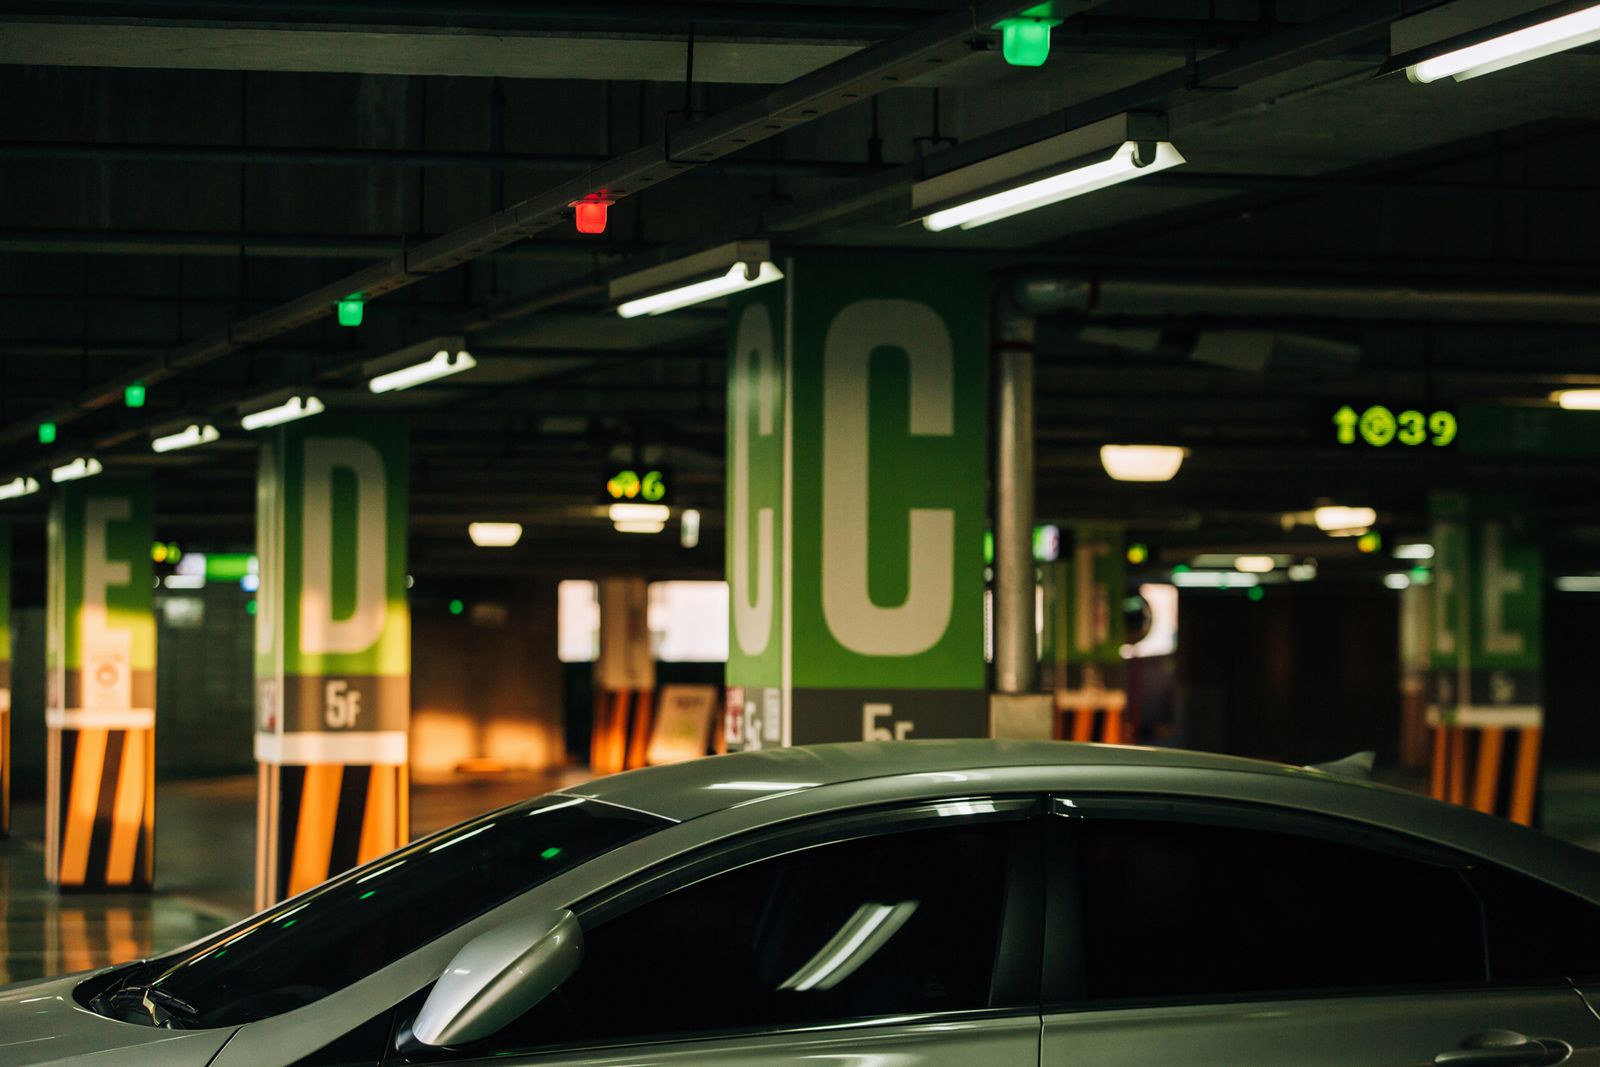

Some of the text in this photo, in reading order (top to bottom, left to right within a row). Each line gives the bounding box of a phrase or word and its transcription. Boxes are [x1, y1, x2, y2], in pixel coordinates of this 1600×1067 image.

[301, 437, 387, 654] D
[641, 470, 666, 500] 6
[734, 302, 774, 656] C
[822, 299, 955, 656] C
[325, 680, 361, 728] 5F
